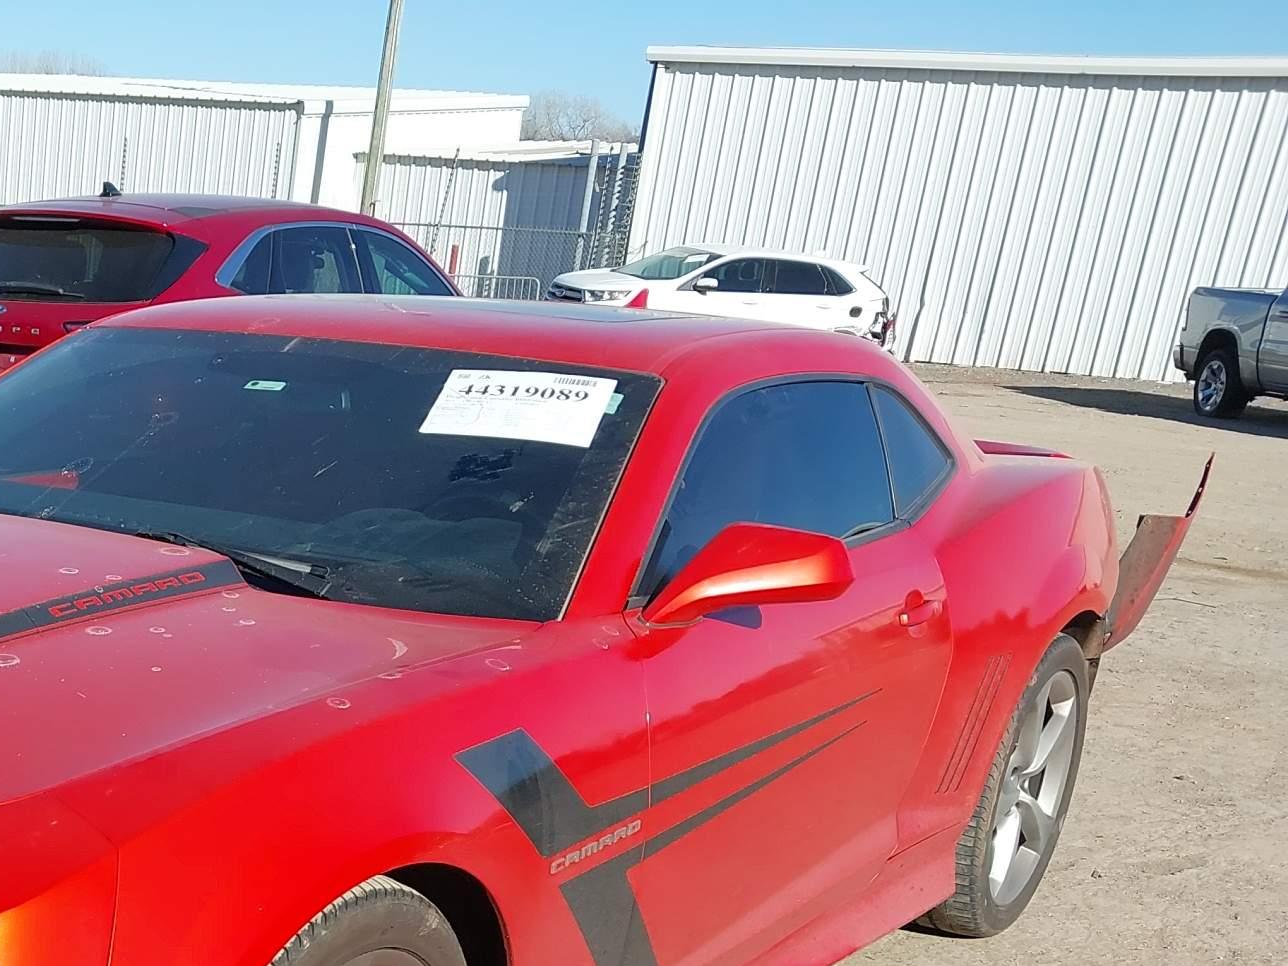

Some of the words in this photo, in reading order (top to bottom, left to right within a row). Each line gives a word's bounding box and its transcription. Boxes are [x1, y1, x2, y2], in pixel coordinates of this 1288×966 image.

[458, 383, 590, 402] 44319089
[48, 571, 206, 617] CAMARO
[550, 819, 642, 875] CAMARO
